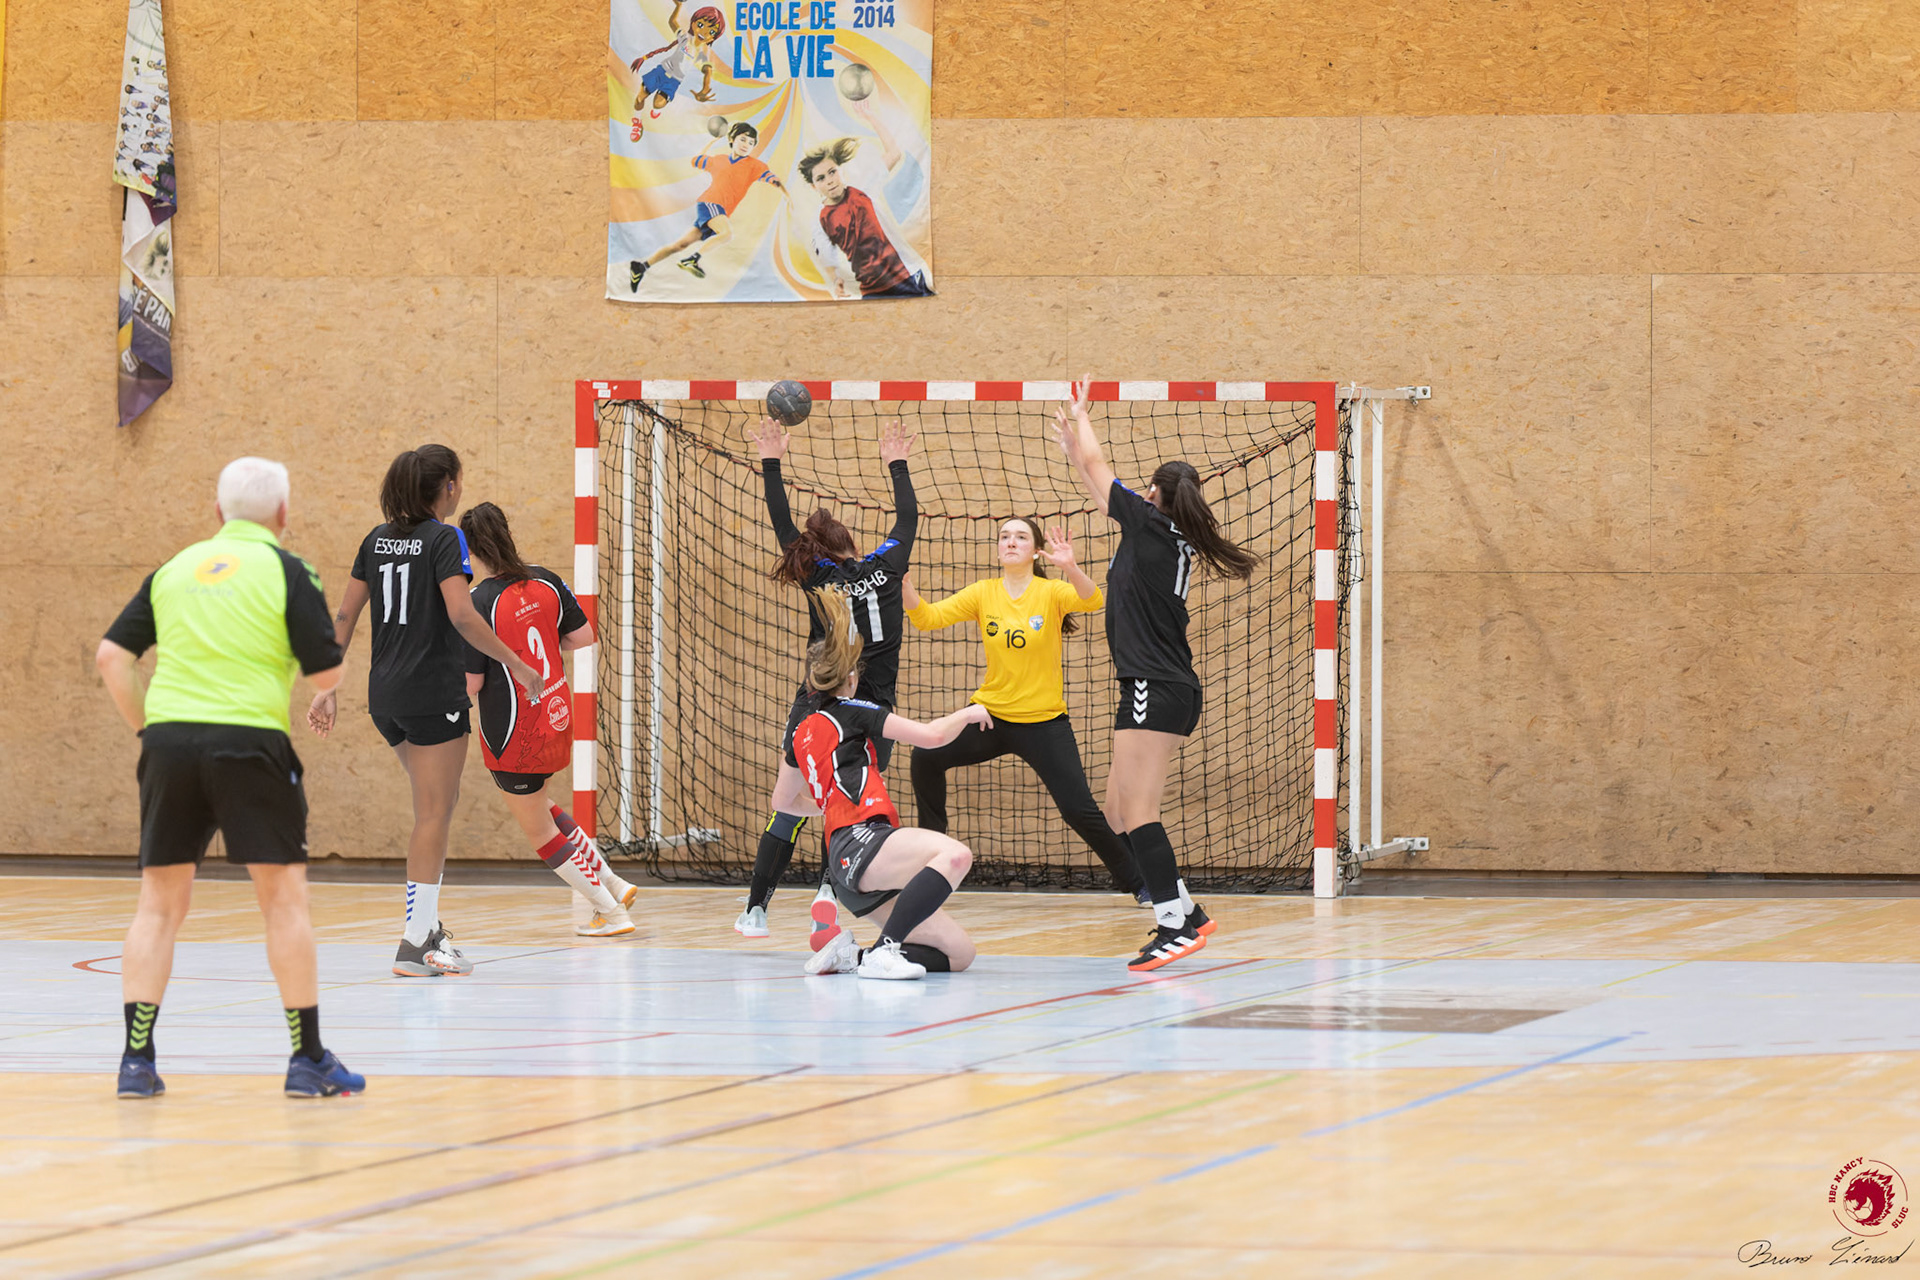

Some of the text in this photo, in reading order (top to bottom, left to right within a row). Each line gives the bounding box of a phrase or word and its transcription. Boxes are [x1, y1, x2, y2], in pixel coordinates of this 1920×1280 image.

[735, 1, 836, 30] ECOLE DE
[853, 5, 895, 28] 2014
[733, 34, 835, 79] LA VIE
[379, 562, 410, 625] 11
[527, 626, 550, 681] 9
[1004, 628, 1026, 649] 16
